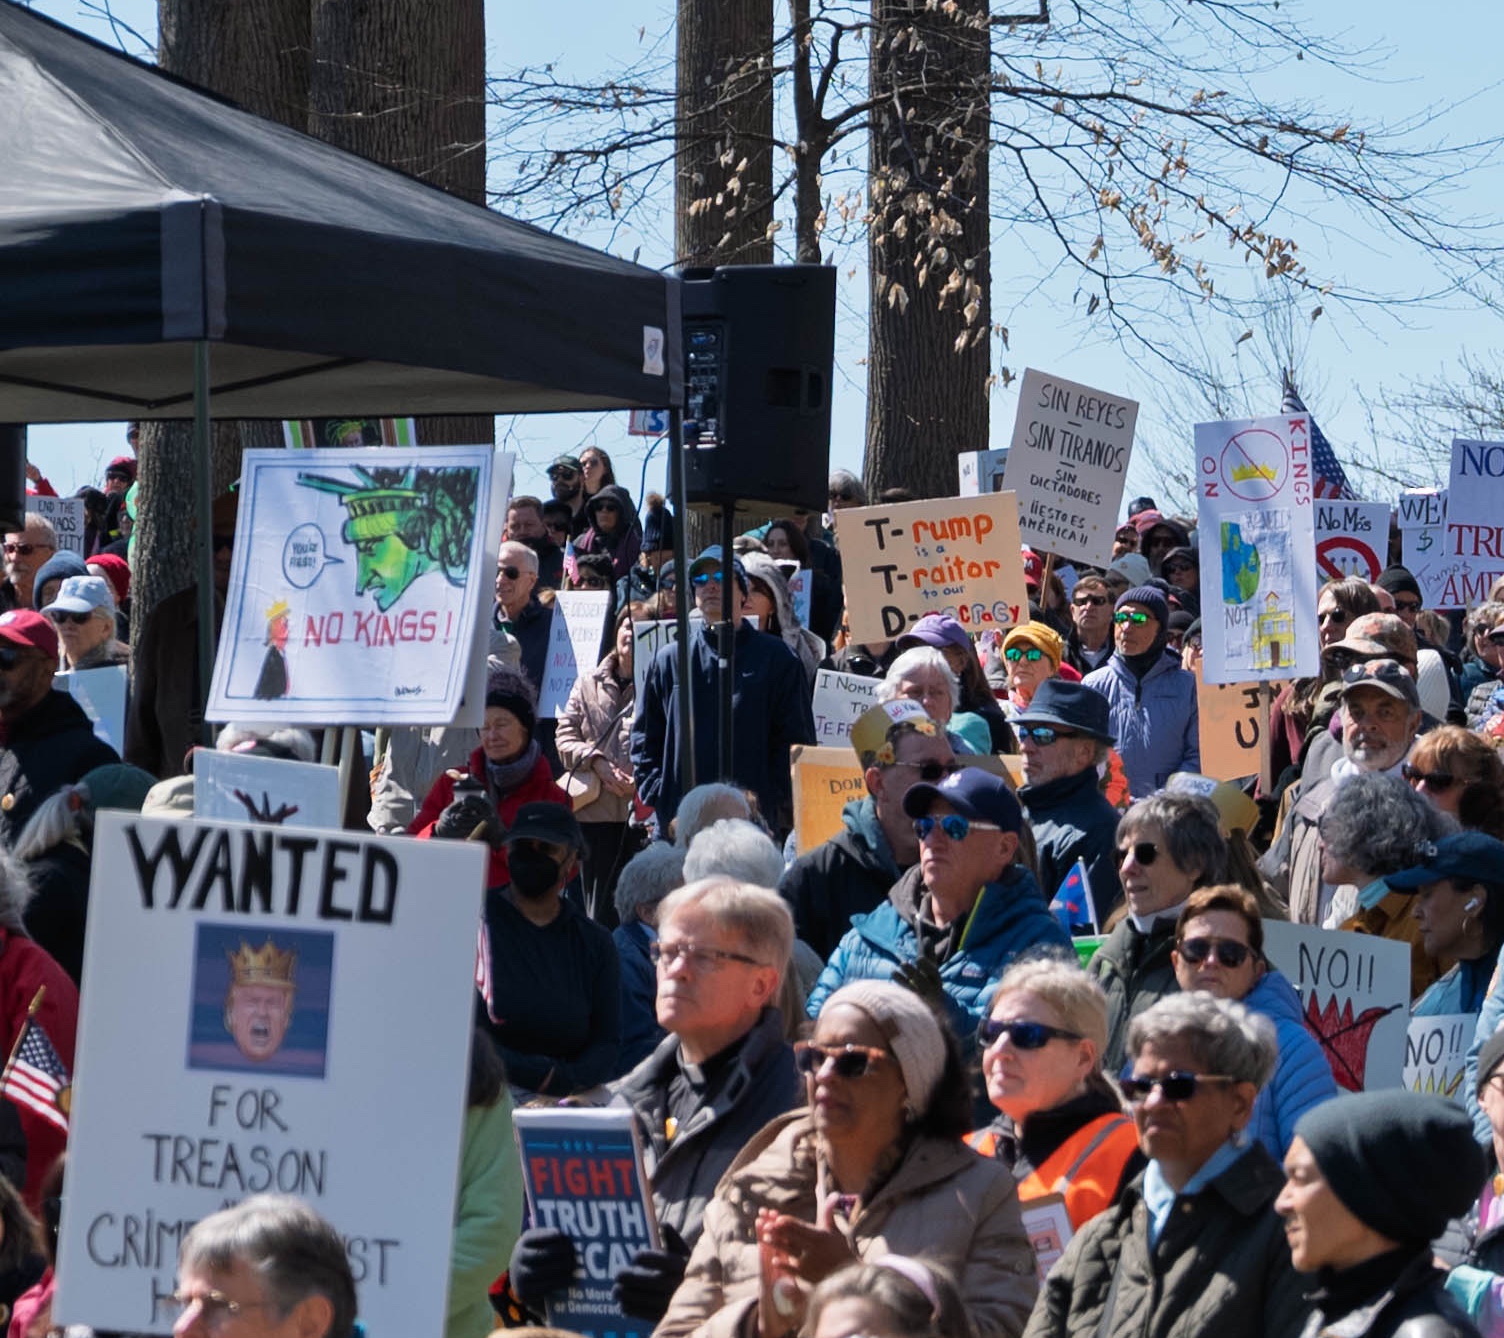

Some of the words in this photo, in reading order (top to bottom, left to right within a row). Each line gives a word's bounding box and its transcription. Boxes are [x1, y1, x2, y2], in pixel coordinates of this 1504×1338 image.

[1038, 383, 1071, 413] SIN
[1075, 394, 1127, 429] REYES
[1025, 421, 1055, 452] SIN
[1060, 429, 1125, 473] TIRANOS
[1289, 419, 1310, 506] KINGS
[1030, 474, 1102, 505] DICTADORES
[1055, 469, 1077, 484] SIN
[38, 499, 55, 514] END
[58, 501, 75, 514] THE
[1071, 514, 1086, 529] ES
[1399, 495, 1441, 525] WE
[58, 533, 83, 551] ELTY
[914, 545, 928, 557] is
[936, 545, 945, 553] a
[922, 587, 938, 599] to
[943, 586, 965, 596] our
[304, 612, 344, 648] NO
[819, 674, 831, 689] I
[829, 779, 862, 794] DON
[125, 824, 401, 925] WANTED
[1299, 942, 1374, 994] NO!!
[1405, 1023, 1464, 1067] NO!!
[208, 1085, 289, 1132] FOR
[142, 1133, 326, 1196] TREASON
[530, 1157, 634, 1195] FIGHT
[537, 1199, 645, 1237] TRUTH
[87, 1210, 199, 1269] CRIM
[573, 1241, 649, 1280] ECA
